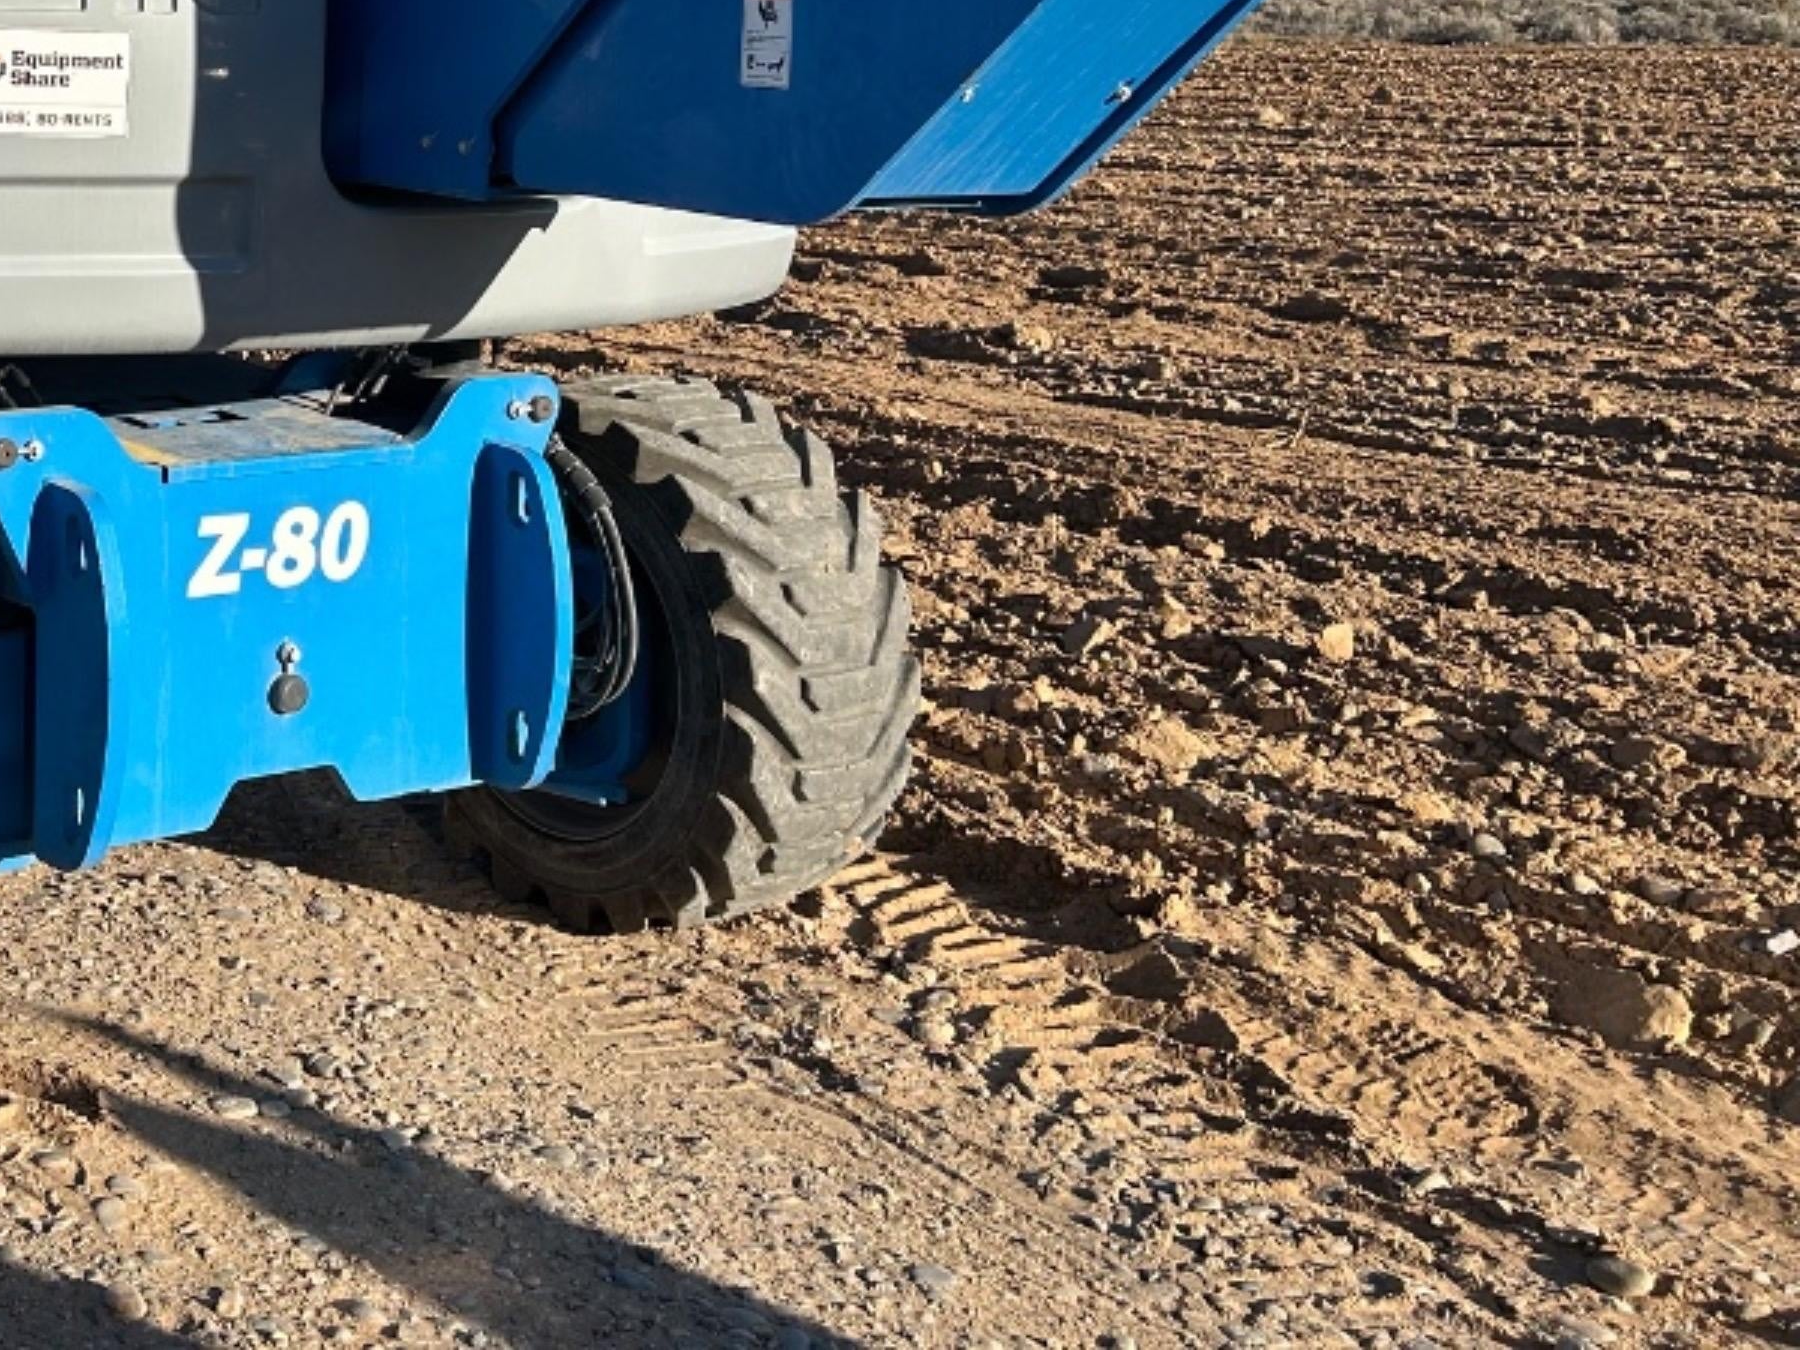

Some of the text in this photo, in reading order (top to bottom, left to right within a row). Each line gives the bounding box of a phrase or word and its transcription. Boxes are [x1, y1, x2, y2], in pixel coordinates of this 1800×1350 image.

[11, 50, 124, 70] Equipment
[11, 70, 70, 87] Share
[186, 500, 370, 599] Z-80
